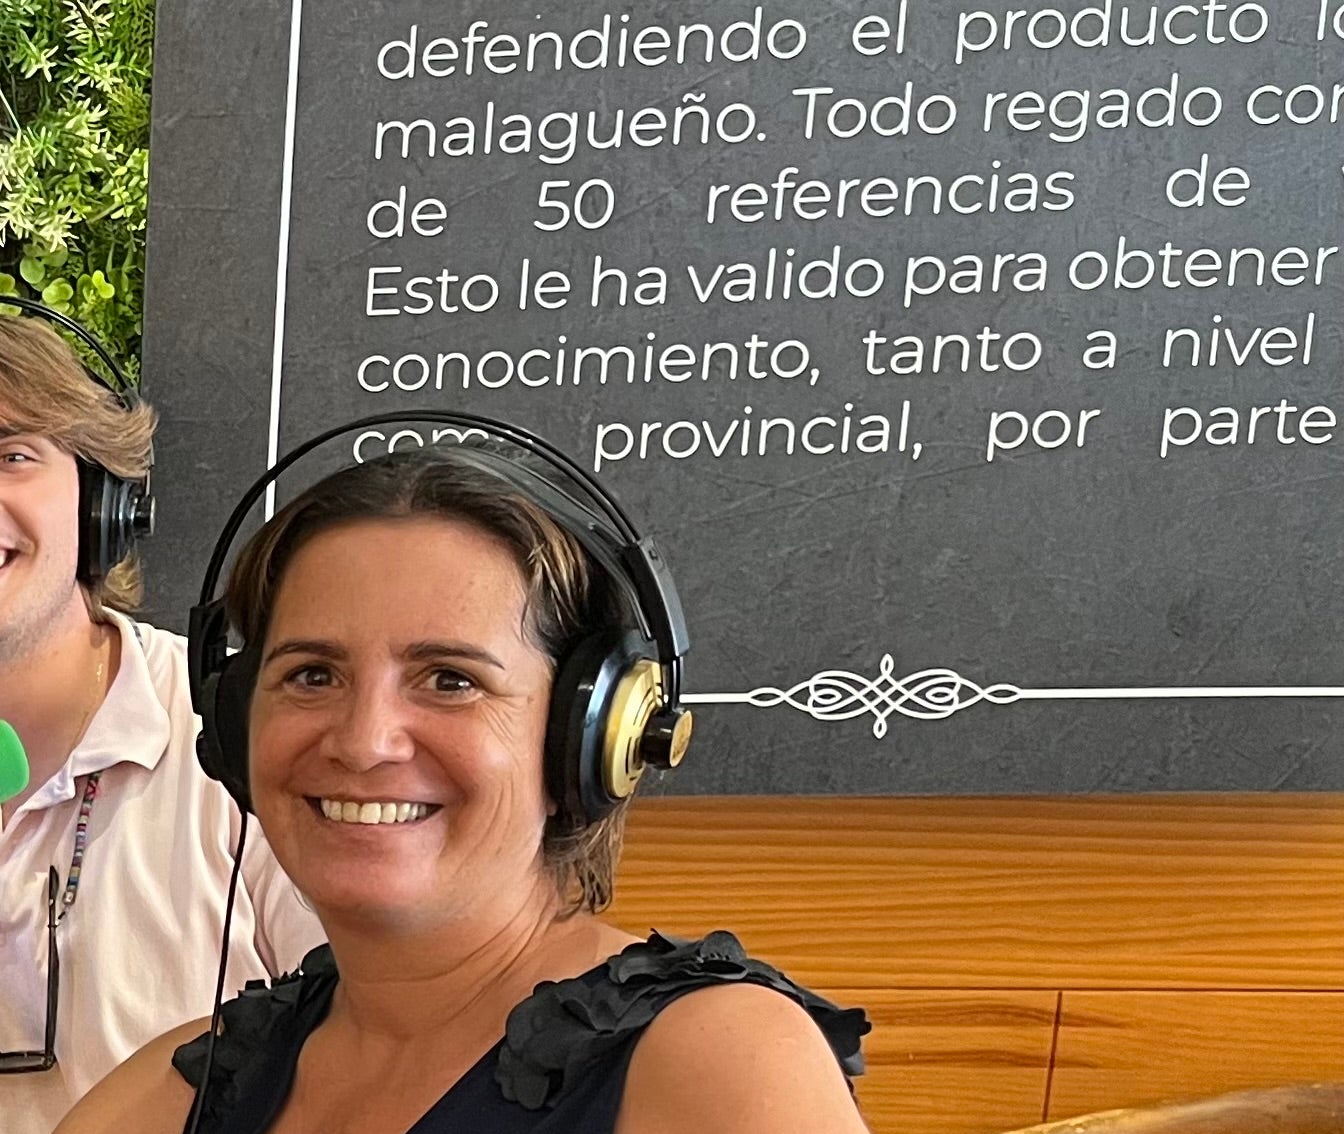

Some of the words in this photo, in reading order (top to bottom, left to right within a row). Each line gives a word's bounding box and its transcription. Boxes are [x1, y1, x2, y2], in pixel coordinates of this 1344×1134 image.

[377, 6, 807, 80] defendiendo
[852, 0, 908, 56] el
[955, 0, 1269, 65] producto
[374, 92, 767, 164] malagueño.
[791, 81, 957, 140] Todo
[983, 72, 1223, 143] regado
[367, 185, 448, 238] de
[533, 178, 615, 231] 50
[707, 160, 1075, 224] referencias
[1166, 153, 1251, 208] de
[366, 266, 499, 316] Esto
[519, 258, 571, 310] le
[591, 255, 667, 307] ha
[687, 245, 885, 303] valido
[903, 252, 1048, 308] para
[1068, 235, 1339, 290] obtener
[357, 331, 820, 392] conocimiento,
[862, 326, 1042, 375] tanto
[1082, 330, 1117, 369] a
[1163, 312, 1315, 368] nivel
[594, 400, 923, 473] provincial,
[986, 409, 1101, 462] por
[1160, 399, 1337, 458] parte
